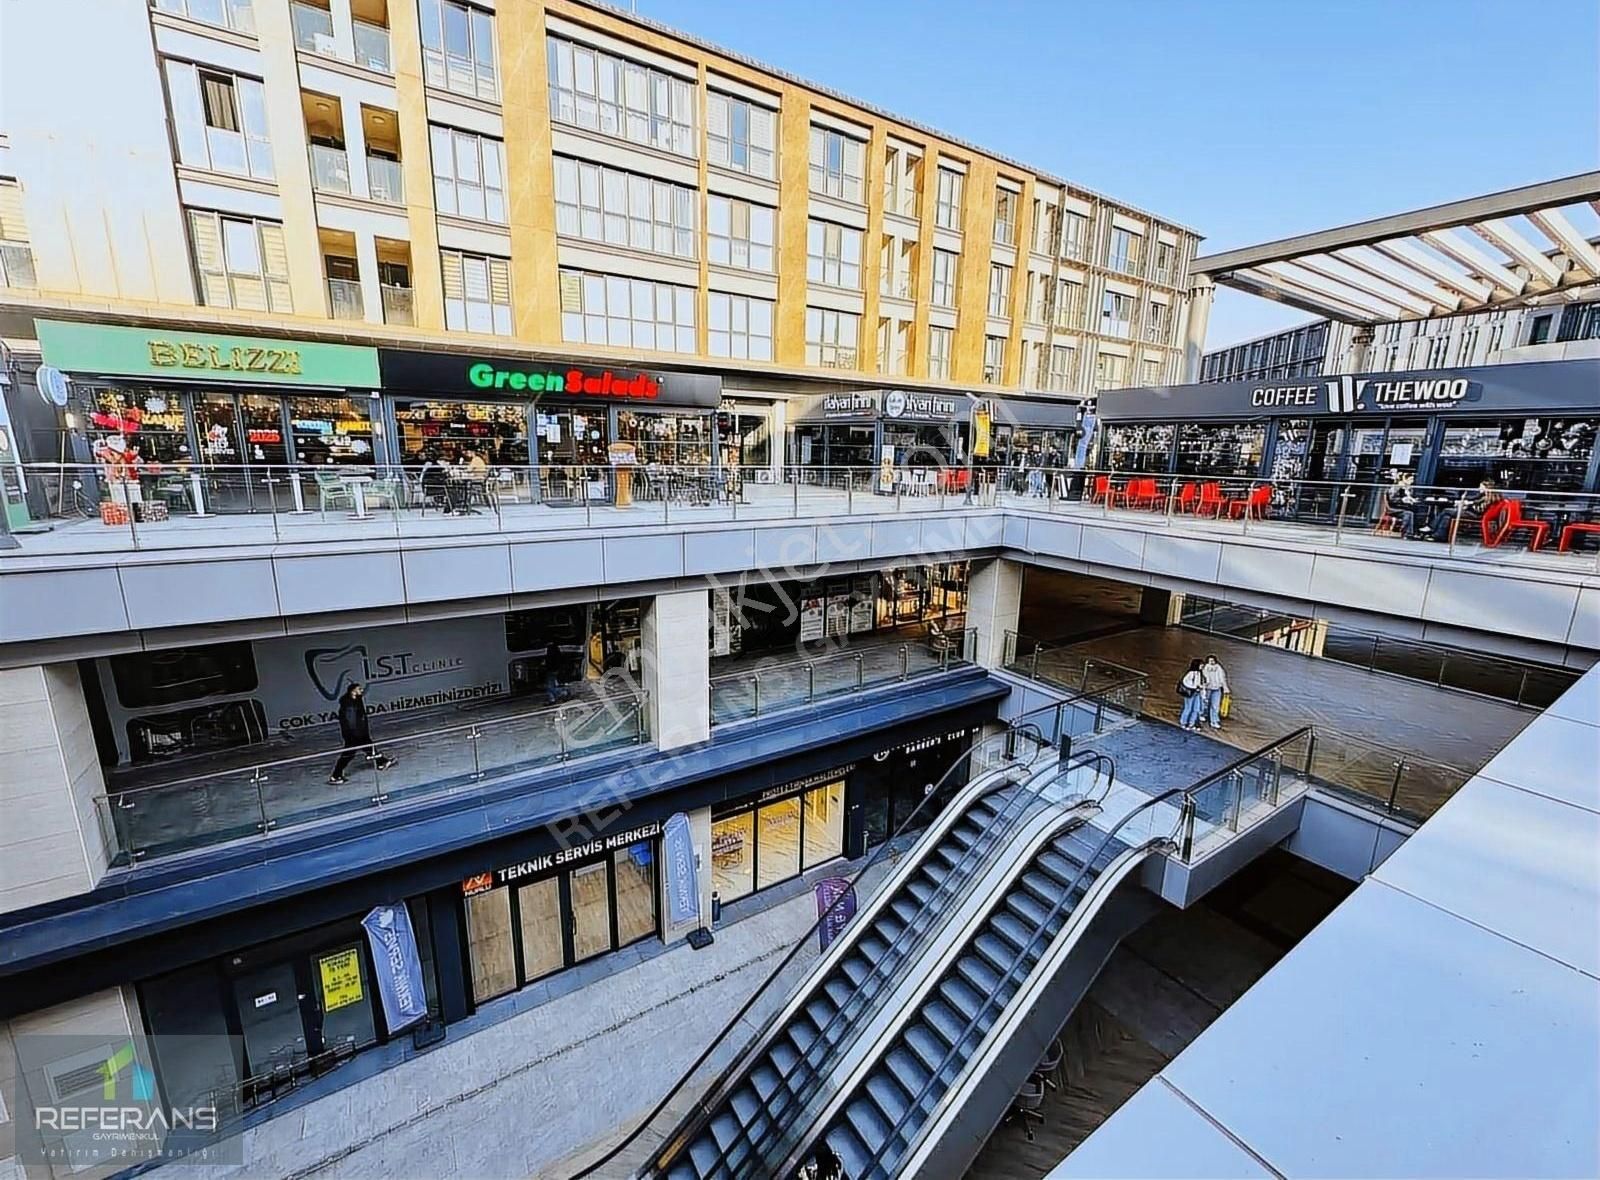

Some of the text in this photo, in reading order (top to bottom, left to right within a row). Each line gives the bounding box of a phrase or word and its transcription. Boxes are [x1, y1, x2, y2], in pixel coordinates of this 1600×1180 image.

[147, 341, 303, 375] BELIZZI
[468, 363, 659, 398] GreenSalads
[1251, 385, 1319, 407] COFFEE
[279, 714, 313, 730] ÇOK
[497, 820, 660, 882] TEKNİK SERVİS MERKEZİ
